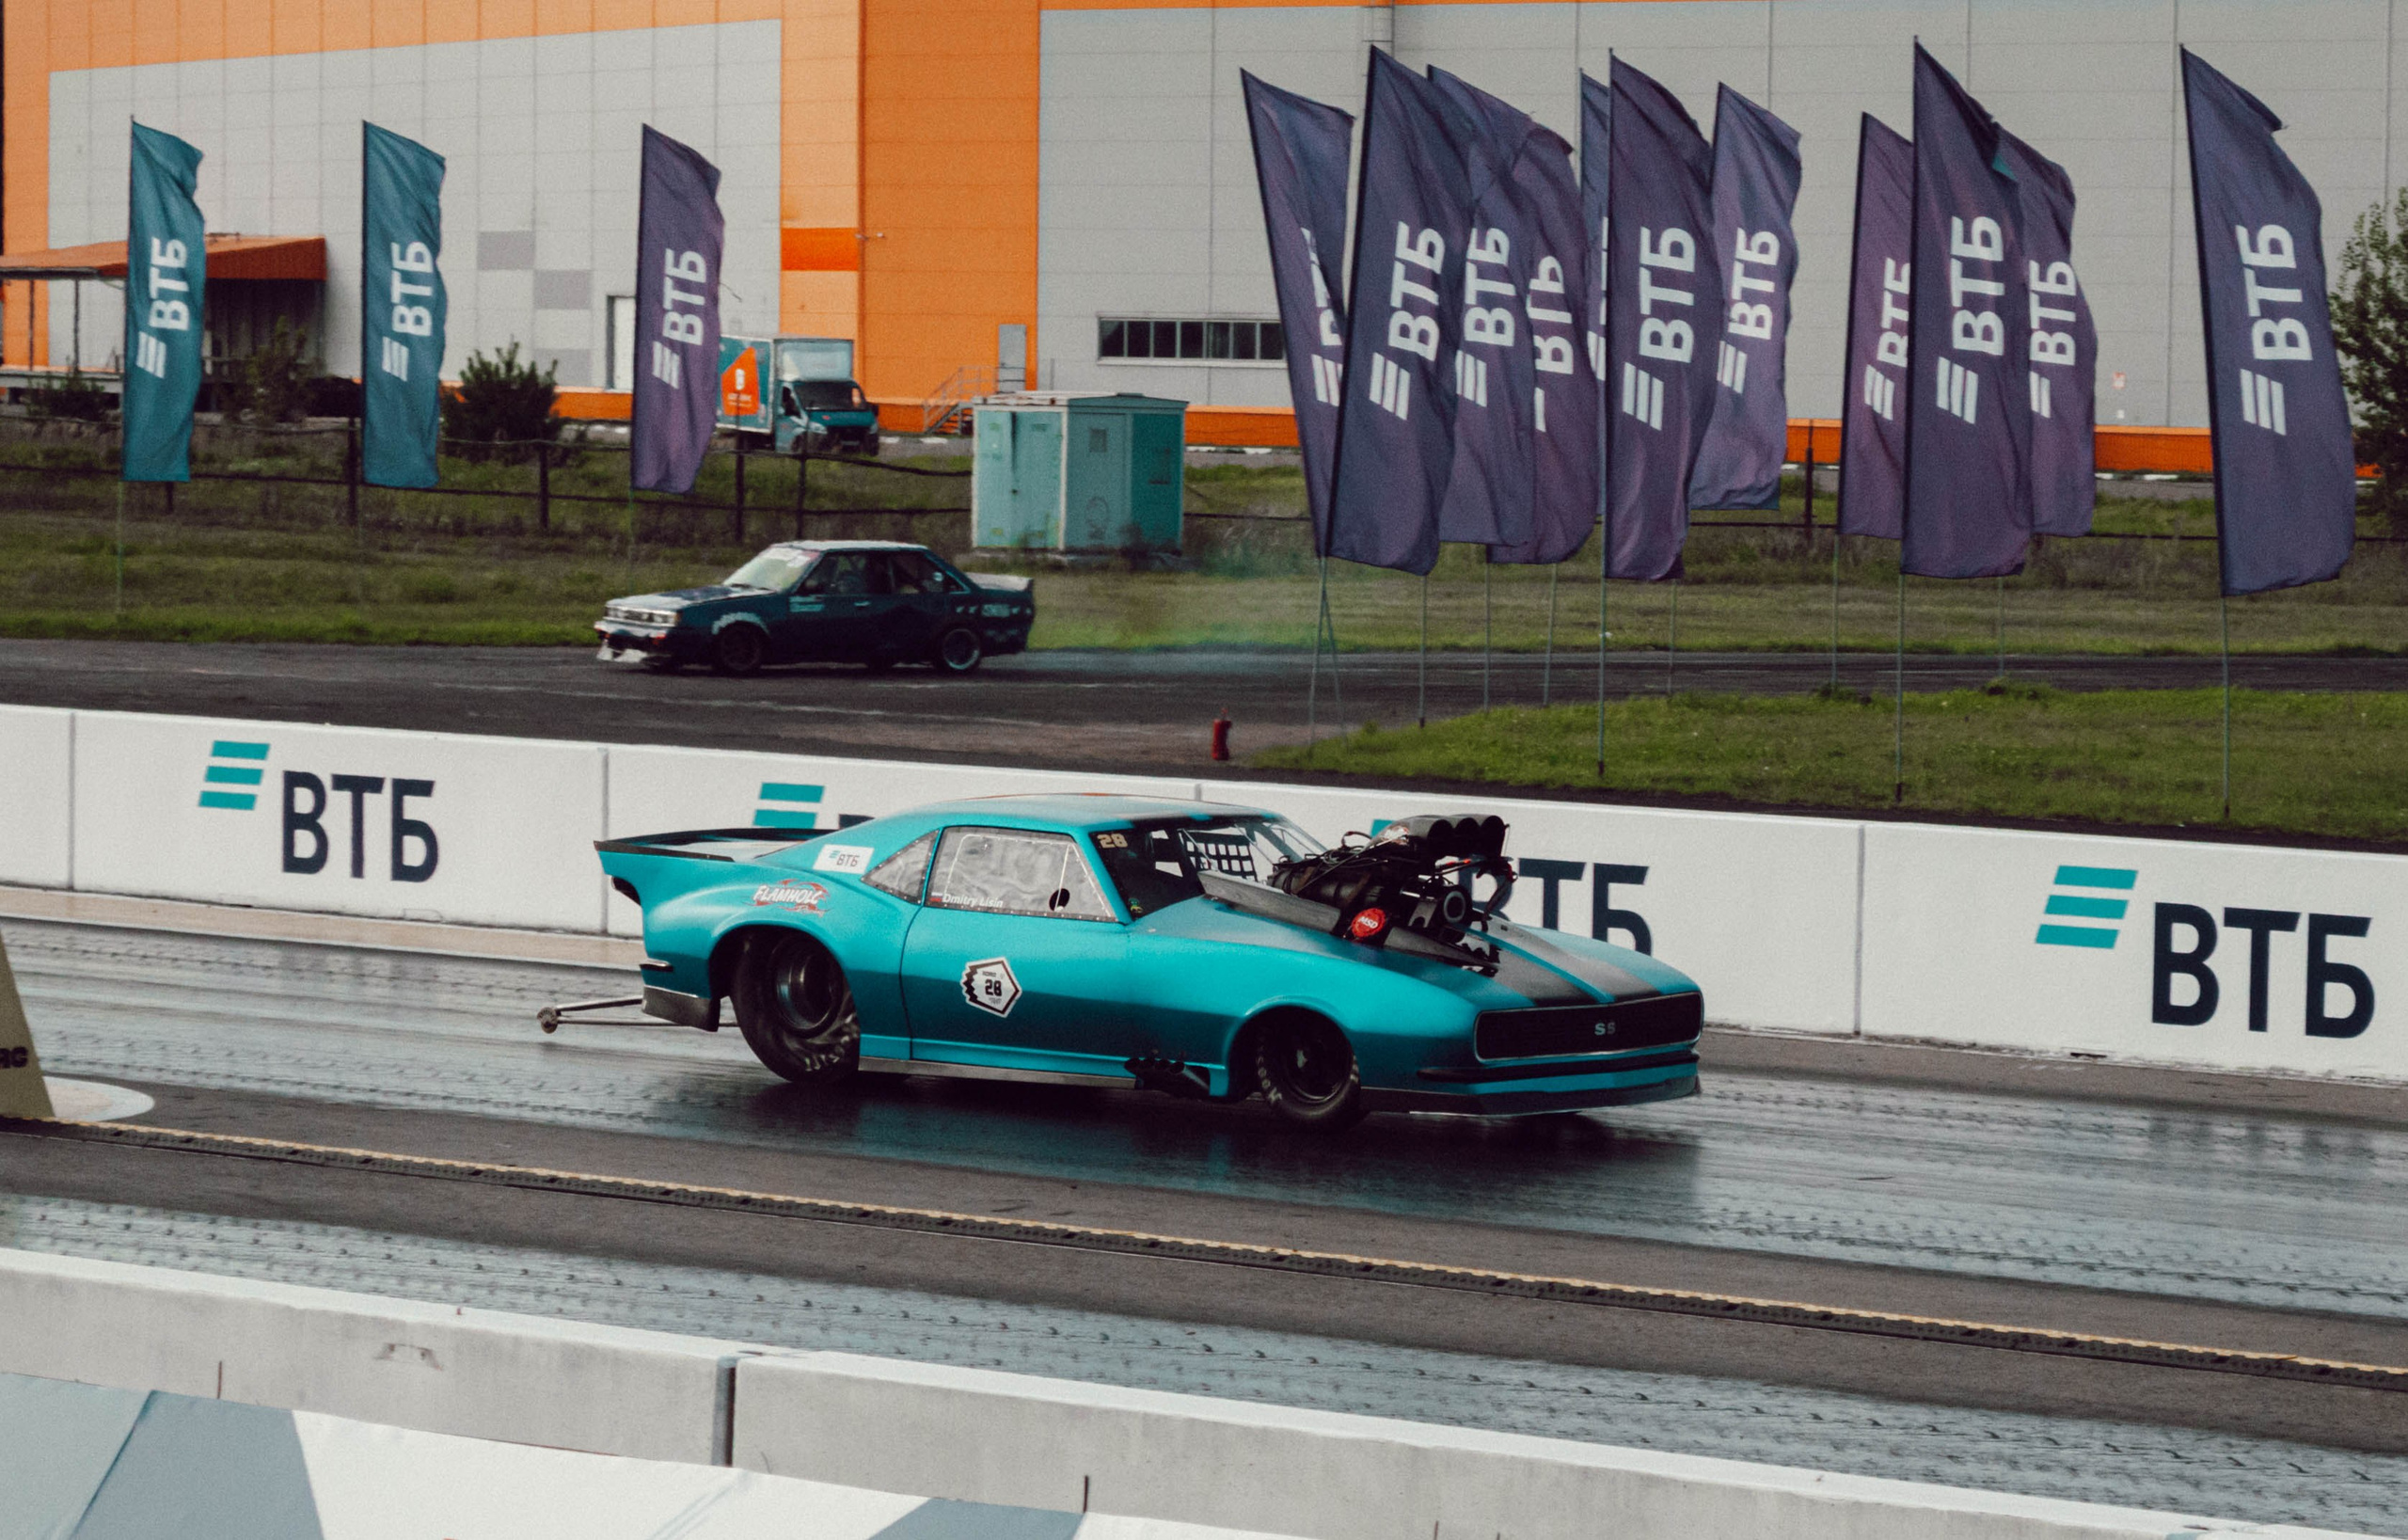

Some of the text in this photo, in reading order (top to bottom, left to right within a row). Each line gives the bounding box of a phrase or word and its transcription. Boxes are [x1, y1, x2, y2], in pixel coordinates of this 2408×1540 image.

[150, 237, 190, 331] ВТБ
[390, 241, 434, 337] ВТБ
[662, 247, 706, 346] ВТБ
[1387, 220, 1446, 362] ВТБ
[1464, 227, 1517, 347] ВТБ
[1639, 226, 1696, 363] ВТБ
[1728, 227, 1781, 341] ВТБ
[1950, 215, 2005, 357] ВТБ
[2029, 259, 2077, 366] ВТБ
[2235, 224, 2314, 361] ВТБ
[282, 770, 439, 883] ВТБ
[836, 853, 861, 867] ВТБ
[1097, 833, 1129, 849] 28
[942, 894, 1004, 908] Dmitry Lisin
[985, 978, 1003, 997] 28
[2152, 901, 2376, 1039] ВТБ
[1594, 1022, 1616, 1036] SS
